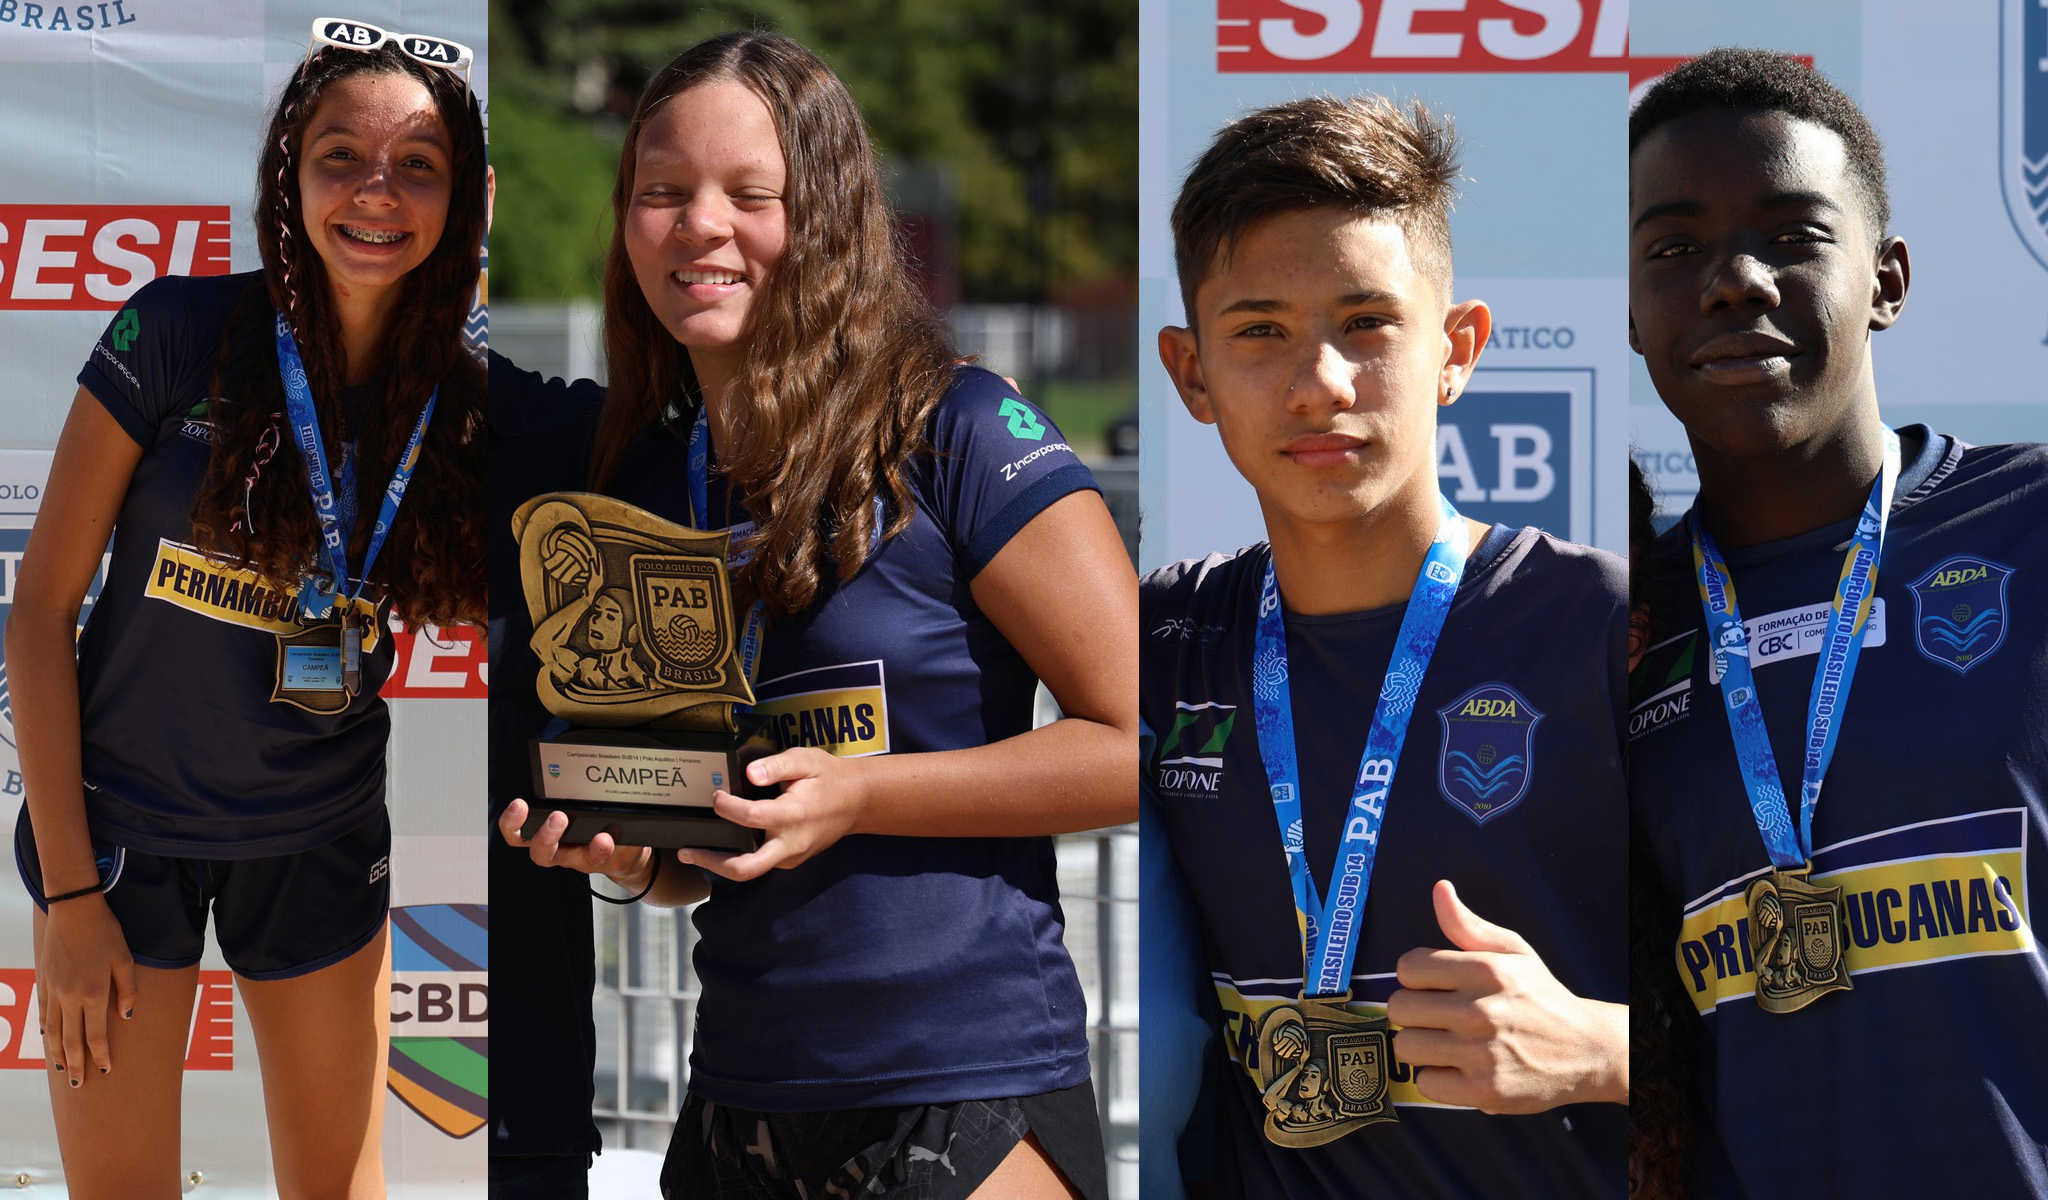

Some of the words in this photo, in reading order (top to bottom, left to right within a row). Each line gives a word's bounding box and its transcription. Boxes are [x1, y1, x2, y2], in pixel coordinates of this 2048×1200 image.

[0, 219, 201, 302] ESI
[1488, 326, 1575, 350] ÁTICO
[1437, 424, 1556, 502] AB
[0, 485, 39, 500] OLO
[638, 562, 663, 571] POLO
[1930, 566, 1987, 587] ABDA
[651, 585, 709, 609] PAB
[1836, 549, 1874, 633] CAMPEONATO
[1757, 612, 1813, 634] FORMAÇÃO
[1815, 609, 1829, 620] DE
[1758, 633, 1793, 656] CBC
[664, 666, 717, 681] BRASIL
[1816, 633, 1851, 716] BRASILEIRO
[1459, 699, 1516, 717] ABDA
[1629, 692, 1691, 735] OPONE
[773, 702, 876, 750] UCANAS
[1809, 717, 1830, 749] SUB
[1807, 750, 1822, 769] 14
[585, 766, 687, 787] CAMPEÃ
[1159, 769, 1222, 791] ZOPONE
[1345, 758, 1394, 845] PAB
[1345, 853, 1365, 873] 14
[1336, 874, 1360, 908] SUB
[1804, 921, 1828, 936] PAB
[1809, 970, 1833, 979] BRASIL
[1340, 1050, 1375, 1067] PAB
[1344, 1102, 1377, 1111] BRASIL
